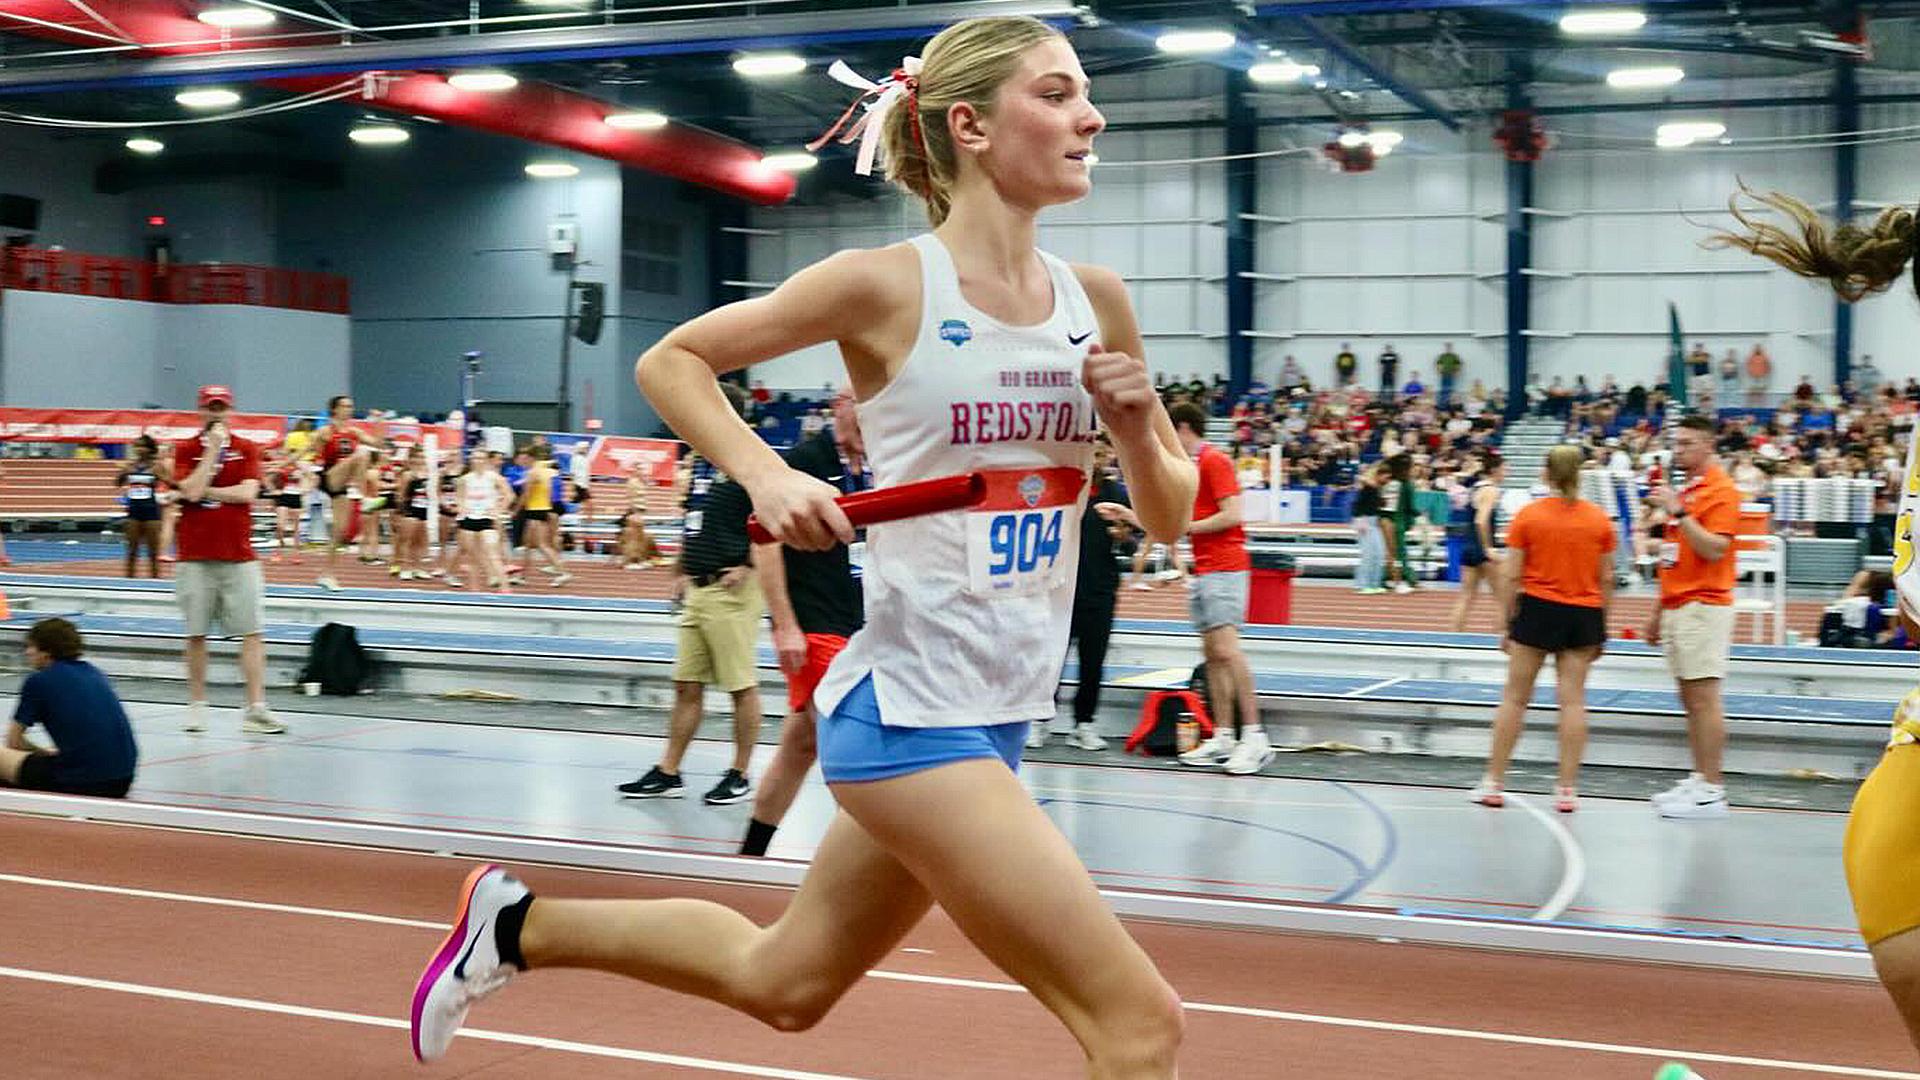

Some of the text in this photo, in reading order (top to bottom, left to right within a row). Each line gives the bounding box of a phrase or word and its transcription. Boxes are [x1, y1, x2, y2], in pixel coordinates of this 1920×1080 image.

[999, 371, 1073, 387] RIO GRANDE
[989, 510, 1063, 575] 904
